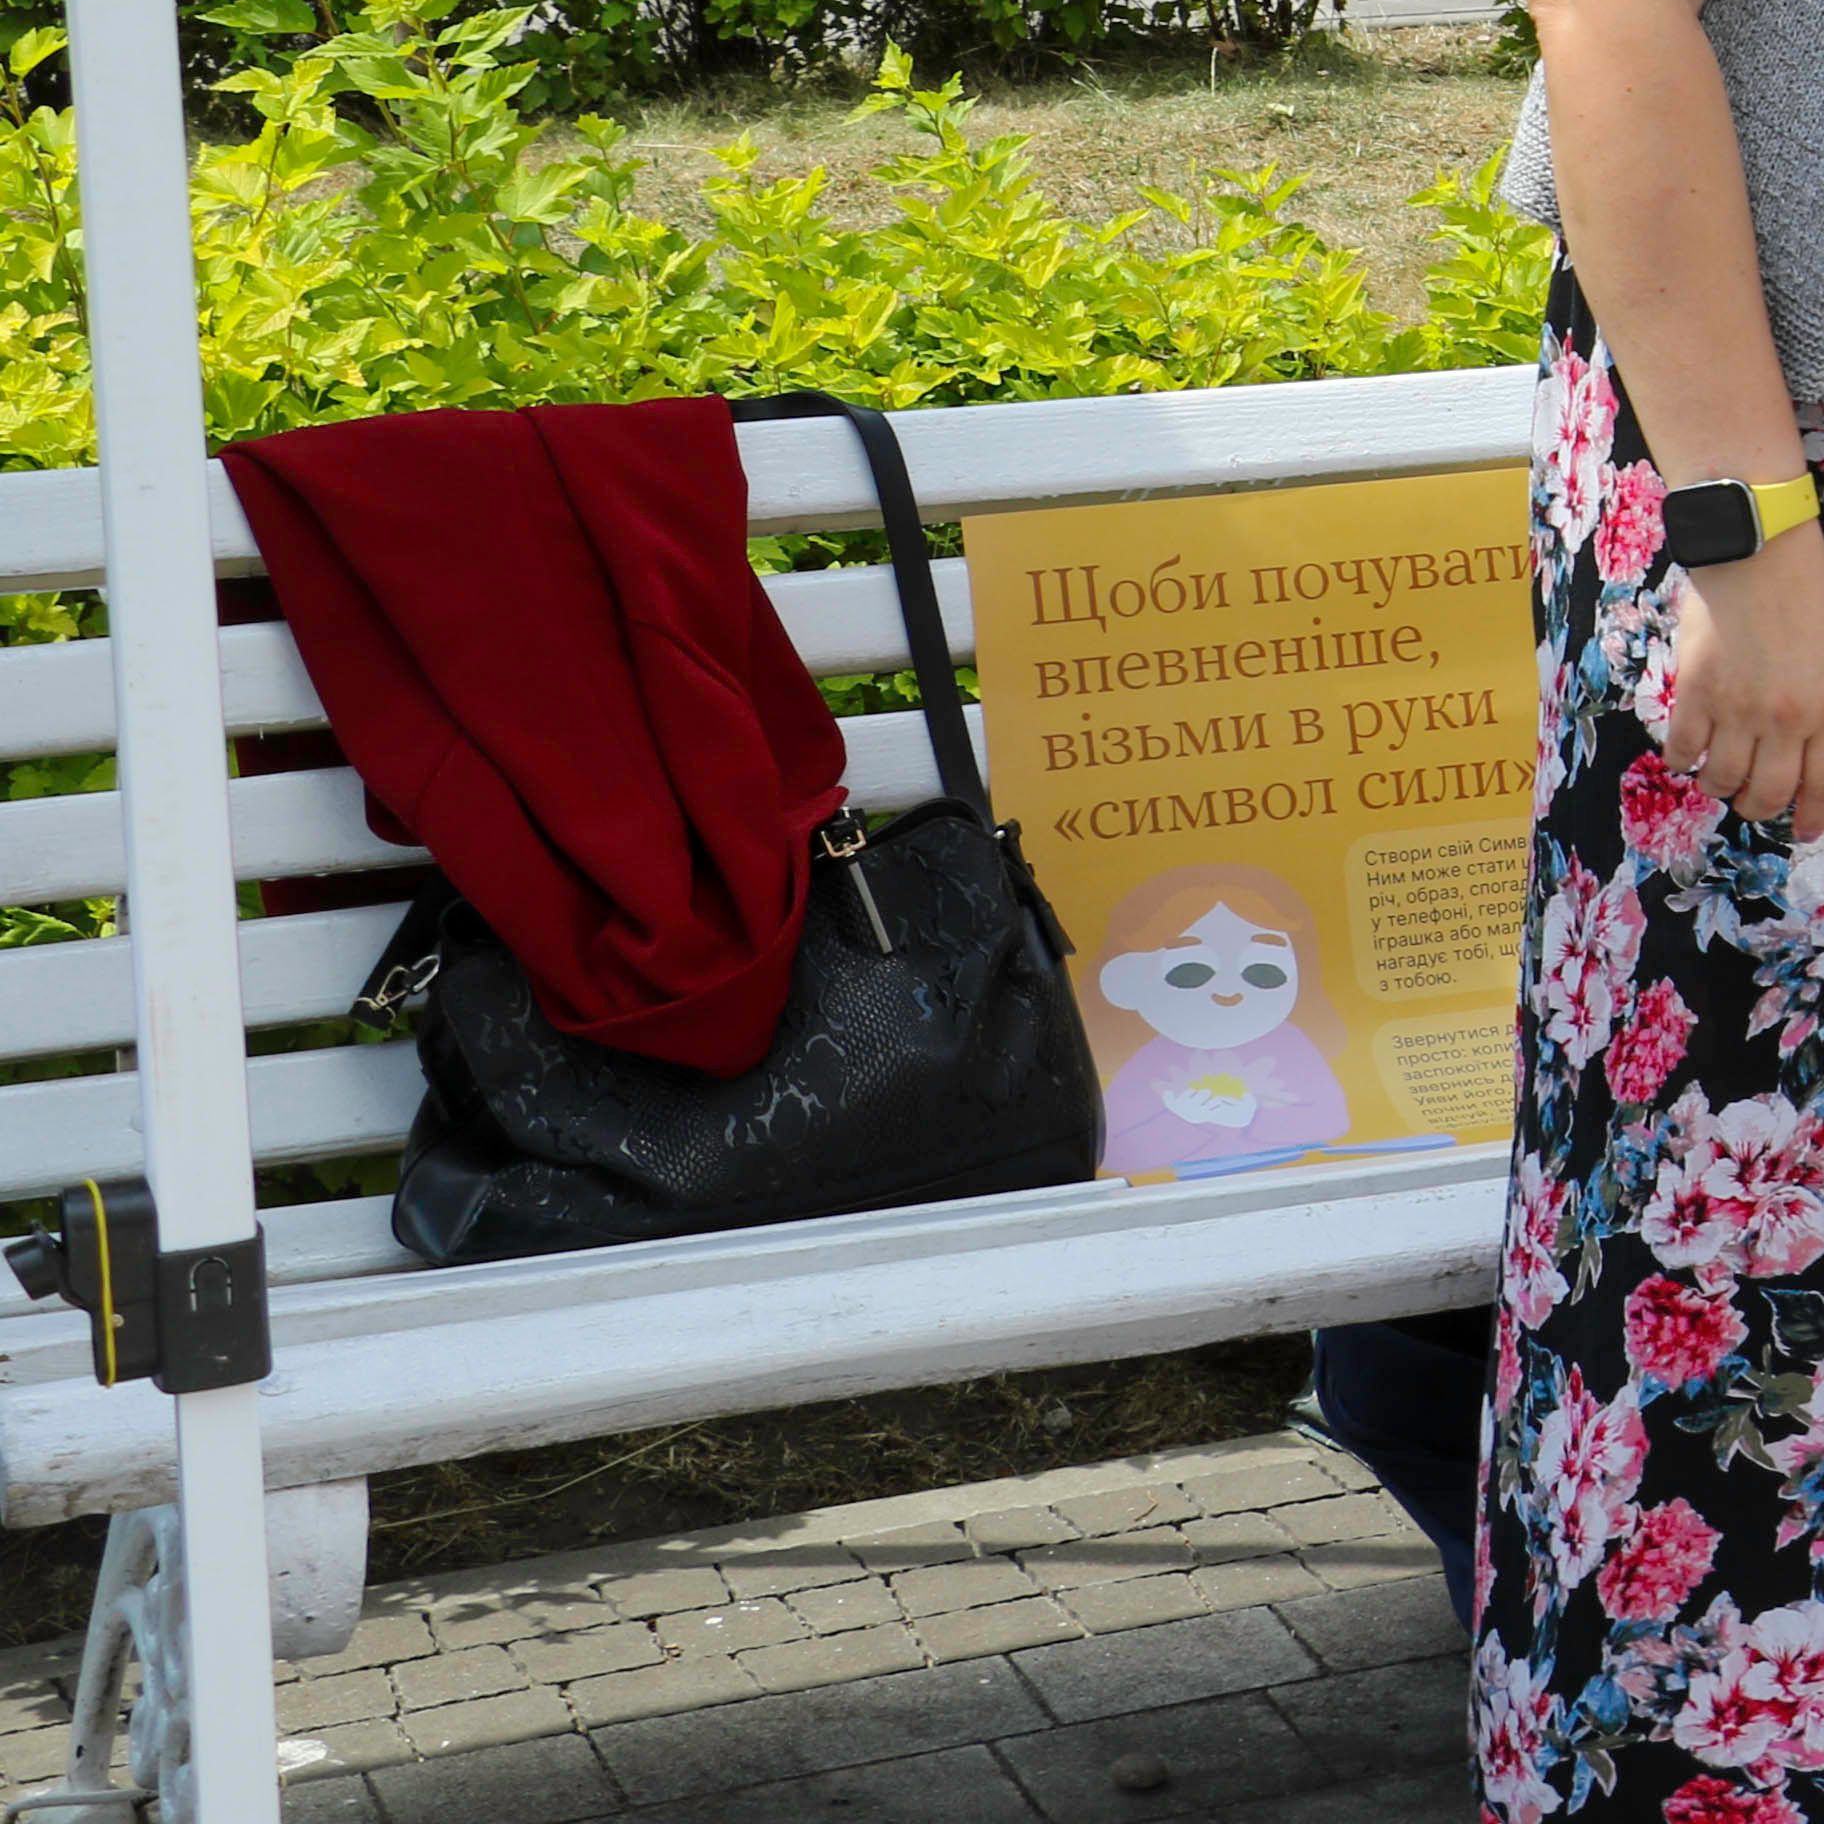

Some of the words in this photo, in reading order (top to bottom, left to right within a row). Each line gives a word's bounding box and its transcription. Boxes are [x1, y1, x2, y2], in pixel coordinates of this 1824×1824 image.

[1026, 554, 1230, 633] Щоби
[1250, 543, 1532, 609] почувати
[1034, 616, 1440, 699] впевненіше,
[1042, 712, 1270, 772] візьми
[1289, 707, 1325, 746] в
[1342, 688, 1499, 756] руки
[1053, 775, 1338, 843] «символ
[1365, 847, 1432, 866] Створи
[1438, 841, 1473, 858] свій
[1479, 836, 1527, 853] Симв
[1367, 872, 1406, 887] Ним
[1411, 864, 1461, 883] може
[1467, 858, 1516, 875] стати
[1369, 895, 1401, 911] річ,
[1406, 885, 1464, 904] образ,
[1371, 917, 1382, 932] у
[1388, 905, 1473, 927] телефоні,
[1373, 928, 1444, 951] іграшка
[1450, 924, 1482, 941] або
[1488, 920, 1522, 936] мал
[1377, 949, 1448, 971] нагадує
[1454, 942, 1494, 961] тобі,
[1379, 979, 1389, 992] з
[1394, 970, 1457, 990] тобою.
[1392, 1025, 1499, 1049] Звернутися
[1396, 1048, 1466, 1067] просто:
[1402, 1058, 1513, 1081] заспокоїтис
[1408, 1076, 1495, 1095] звернись
